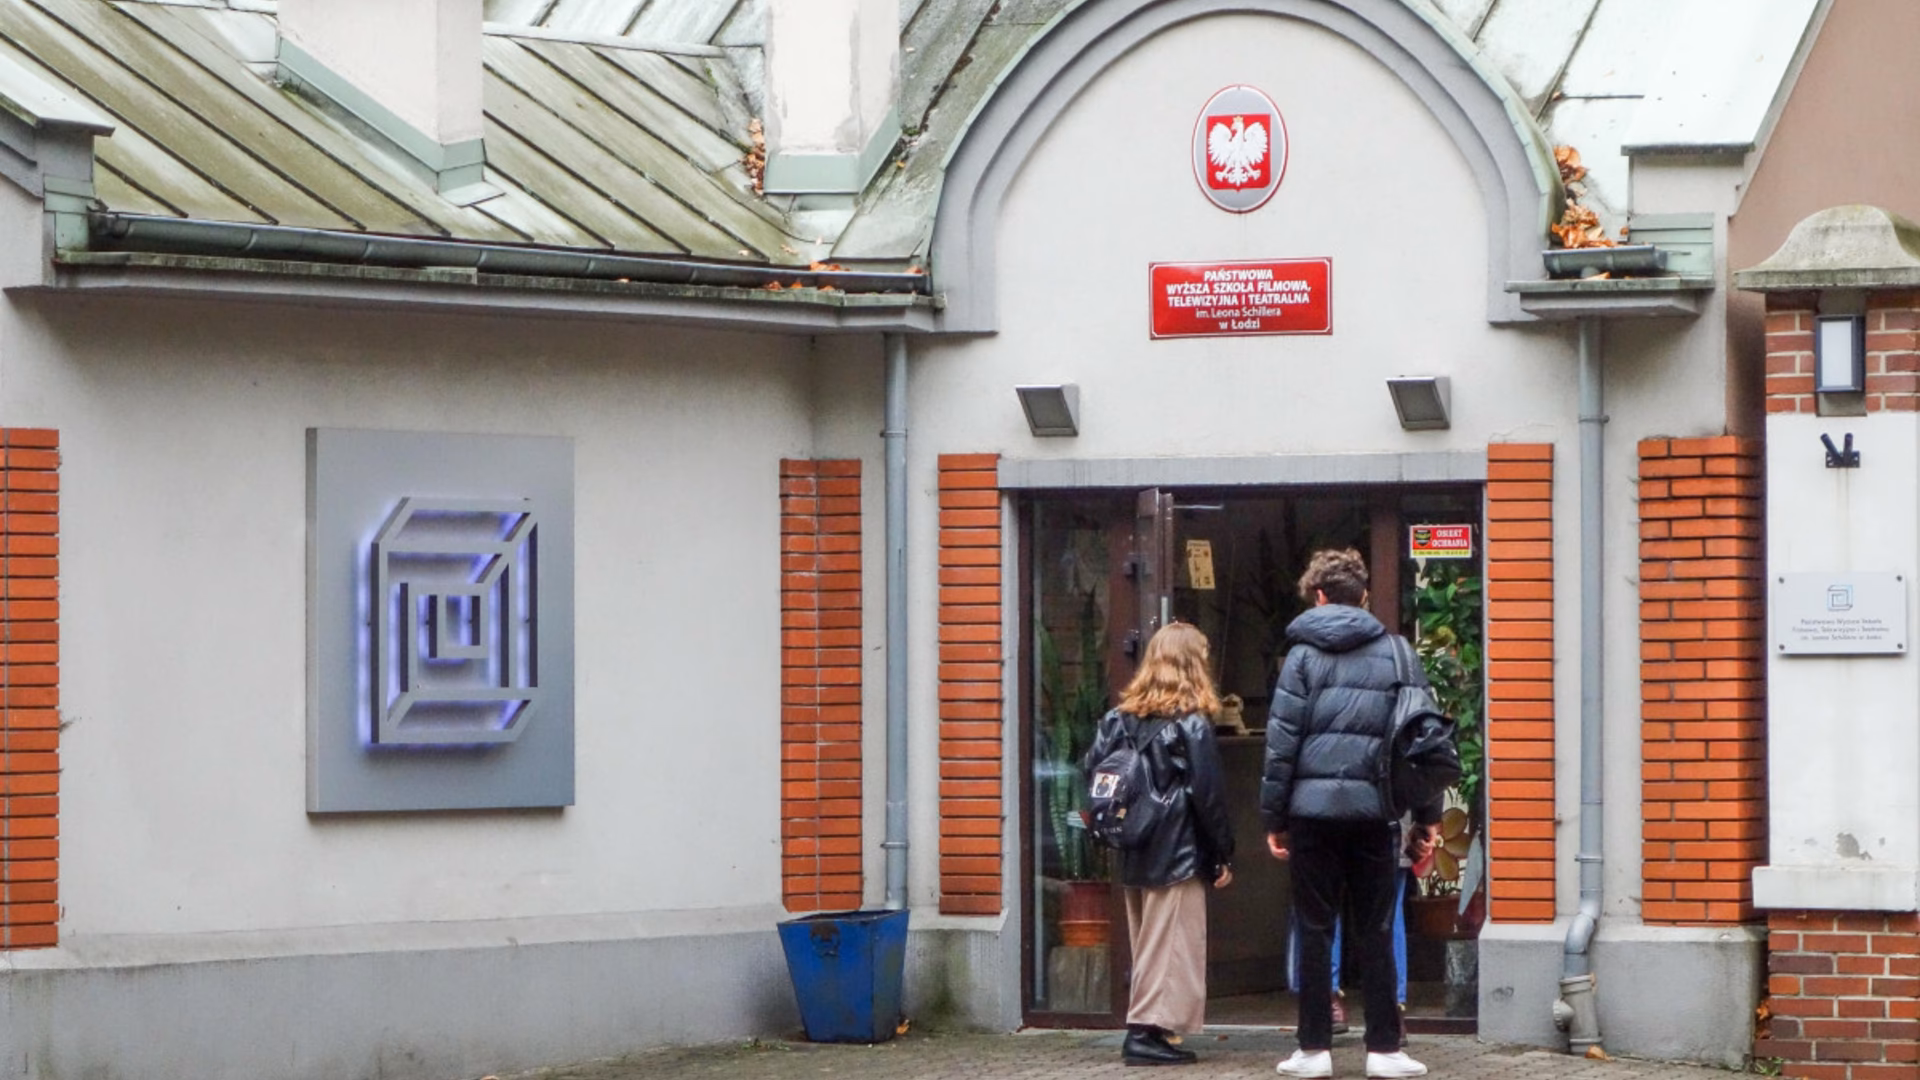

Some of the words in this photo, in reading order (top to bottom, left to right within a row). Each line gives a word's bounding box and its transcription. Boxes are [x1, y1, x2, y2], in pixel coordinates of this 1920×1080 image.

[1204, 268, 1273, 281] PAŃSTWOWA
[1166, 282, 1209, 295] WYŻSZA
[1213, 281, 1254, 294] SZKOŁA
[1258, 280, 1312, 293] FILMOWA,
[1168, 293, 1238, 307] TELEWIZYJNA
[1242, 294, 1245, 305] I
[1249, 292, 1310, 305] TEATRALNA
[1196, 308, 1209, 318] im.
[1211, 307, 1240, 318] Leona
[1242, 306, 1282, 317] Schillera
[1219, 321, 1228, 329] w
[1231, 318, 1260, 329] Łodzi
